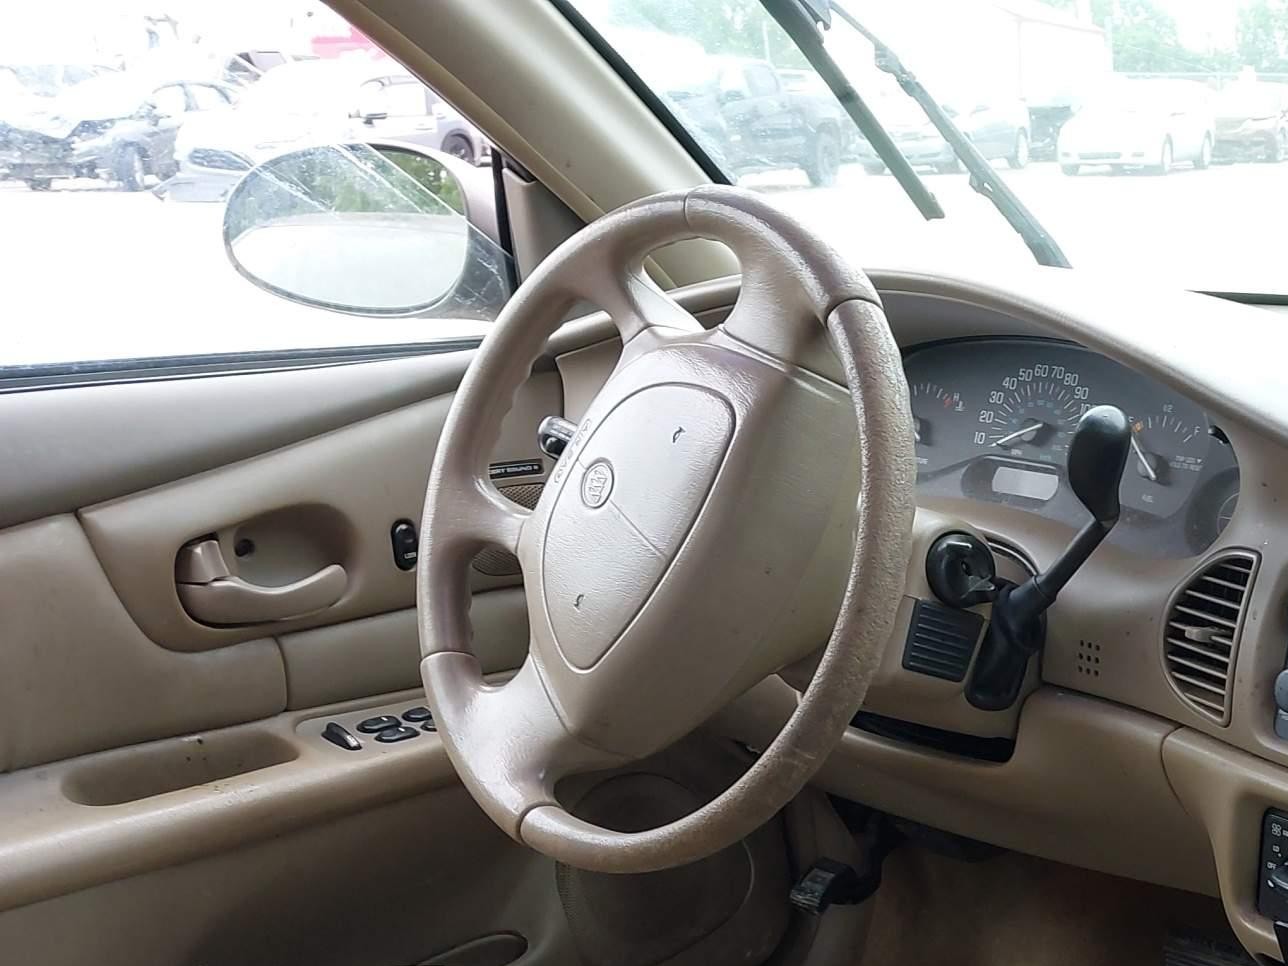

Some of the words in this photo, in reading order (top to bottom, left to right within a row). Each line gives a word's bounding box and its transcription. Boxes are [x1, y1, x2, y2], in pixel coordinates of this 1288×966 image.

[1018, 368, 1033, 381] 50
[1034, 364, 1048, 377] 60
[1051, 366, 1065, 379] 70
[1002, 377, 1017, 390] 40
[1063, 373, 1079, 386] 80
[989, 391, 1004, 404] 30
[1074, 386, 1089, 400] 90
[980, 410, 994, 423] 20
[974, 432, 986, 445] 10
[1266, 862, 1277, 870] OFF
